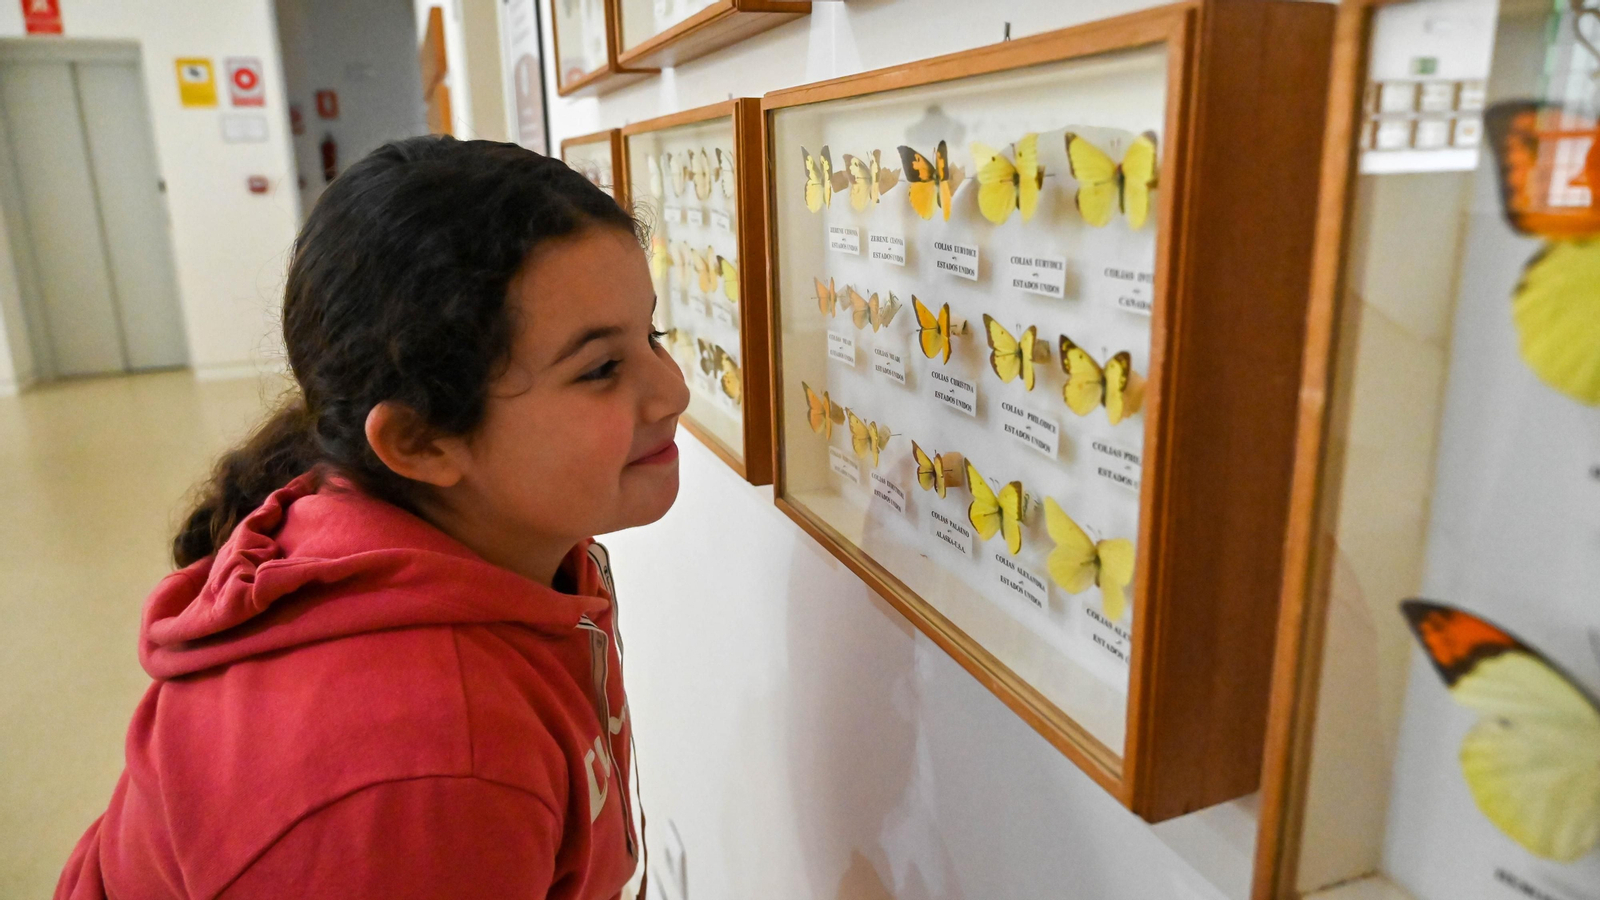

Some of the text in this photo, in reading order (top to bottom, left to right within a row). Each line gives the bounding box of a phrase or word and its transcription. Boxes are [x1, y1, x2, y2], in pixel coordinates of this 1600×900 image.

[870, 235, 888, 243] ZERENE
[873, 252, 892, 260] ESTADOS
[934, 242, 976, 257] COLIAS EURYDICE
[937, 261, 975, 276] ESTADOS UNIDOS
[1010, 256, 1063, 270] COLIAS EURYDICE
[1104, 267, 1134, 280] COLIAS
[1013, 279, 1059, 294] ESTADOS UNIDOS
[874, 348, 888, 358] COLIAS
[875, 365, 891, 375] ESTADOS
[931, 371, 974, 393] COLIAS CHRISTINA
[935, 390, 972, 412] ESTADOS UNIDOS
[1002, 402, 1056, 434] COLIAS PHILODICE
[1004, 424, 1051, 453] ESTADOS UNIDOS
[1092, 442, 1122, 458] COLIAS
[1098, 467, 1132, 486] ESTADOS
[931, 510, 970, 538] COLIAS PALAENO
[996, 554, 1045, 592] COLIAS ALEXANDRA
[1000, 575, 1042, 608] ESTADOS UNIDOS
[1086, 608, 1112, 629] COLIAS
[1093, 634, 1124, 660] ESTADOS
